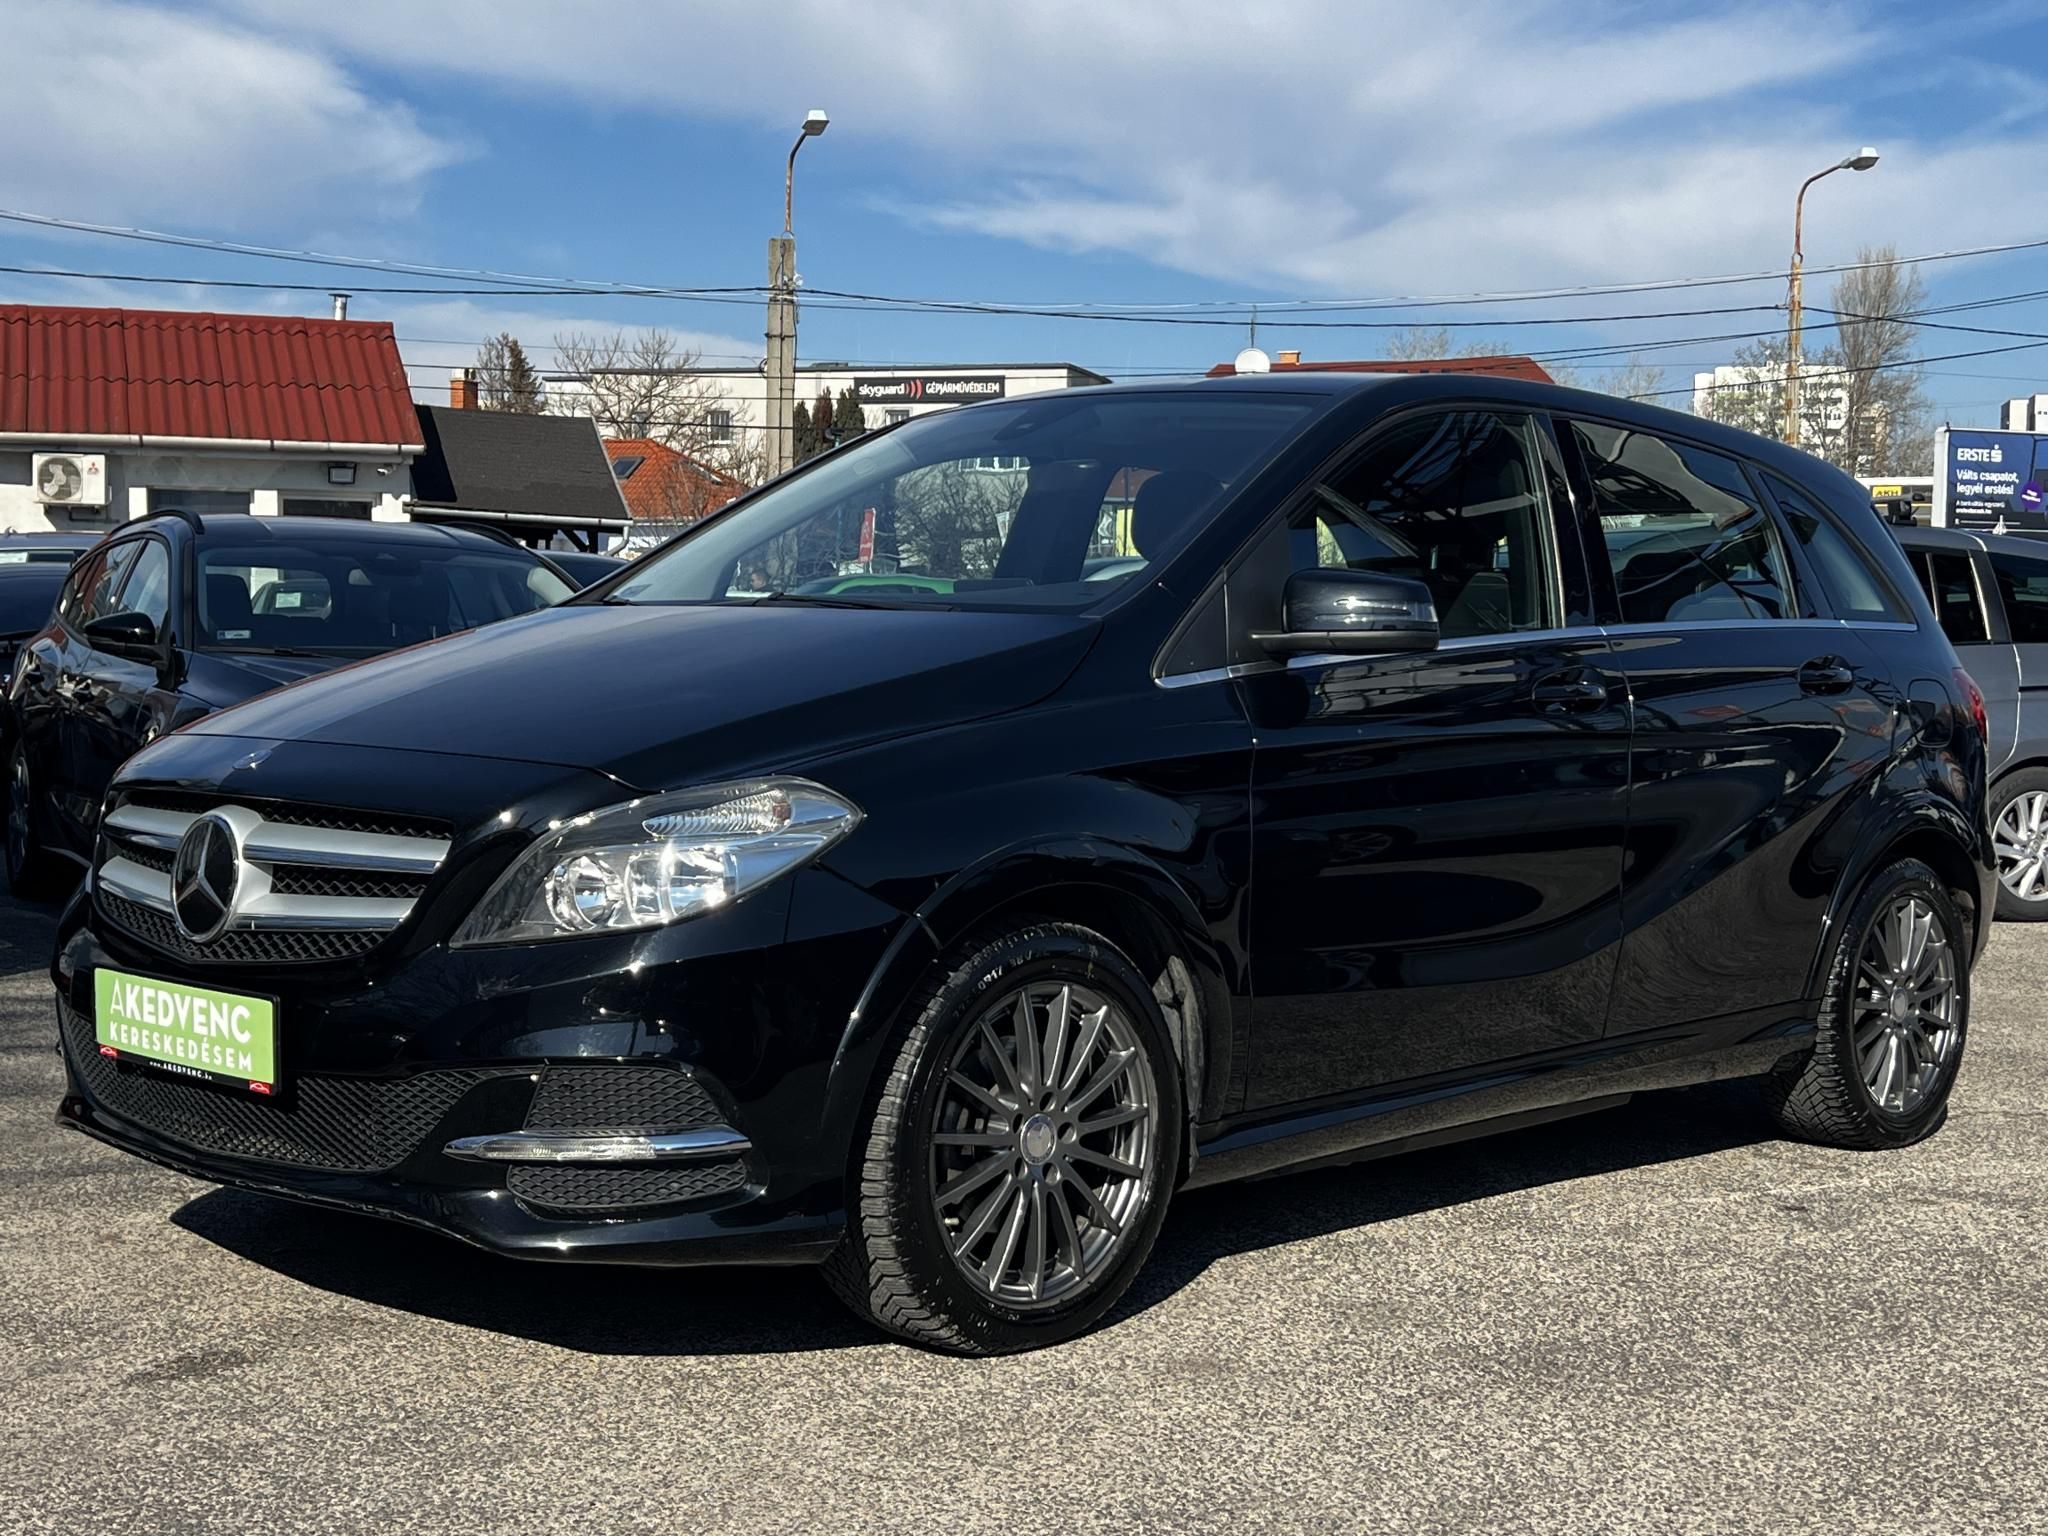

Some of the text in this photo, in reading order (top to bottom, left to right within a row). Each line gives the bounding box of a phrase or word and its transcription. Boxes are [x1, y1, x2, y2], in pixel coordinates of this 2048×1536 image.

[859, 381, 1000, 397] skyguard GÉPJÁRMŰVÉDELEM
[1957, 448, 1990, 462] ERSTE
[1956, 469, 2019, 484] Válts csapatot,
[1956, 483, 2014, 495] legyél erstés!
[110, 1020, 253, 1072] KERESKEDÉSEM
